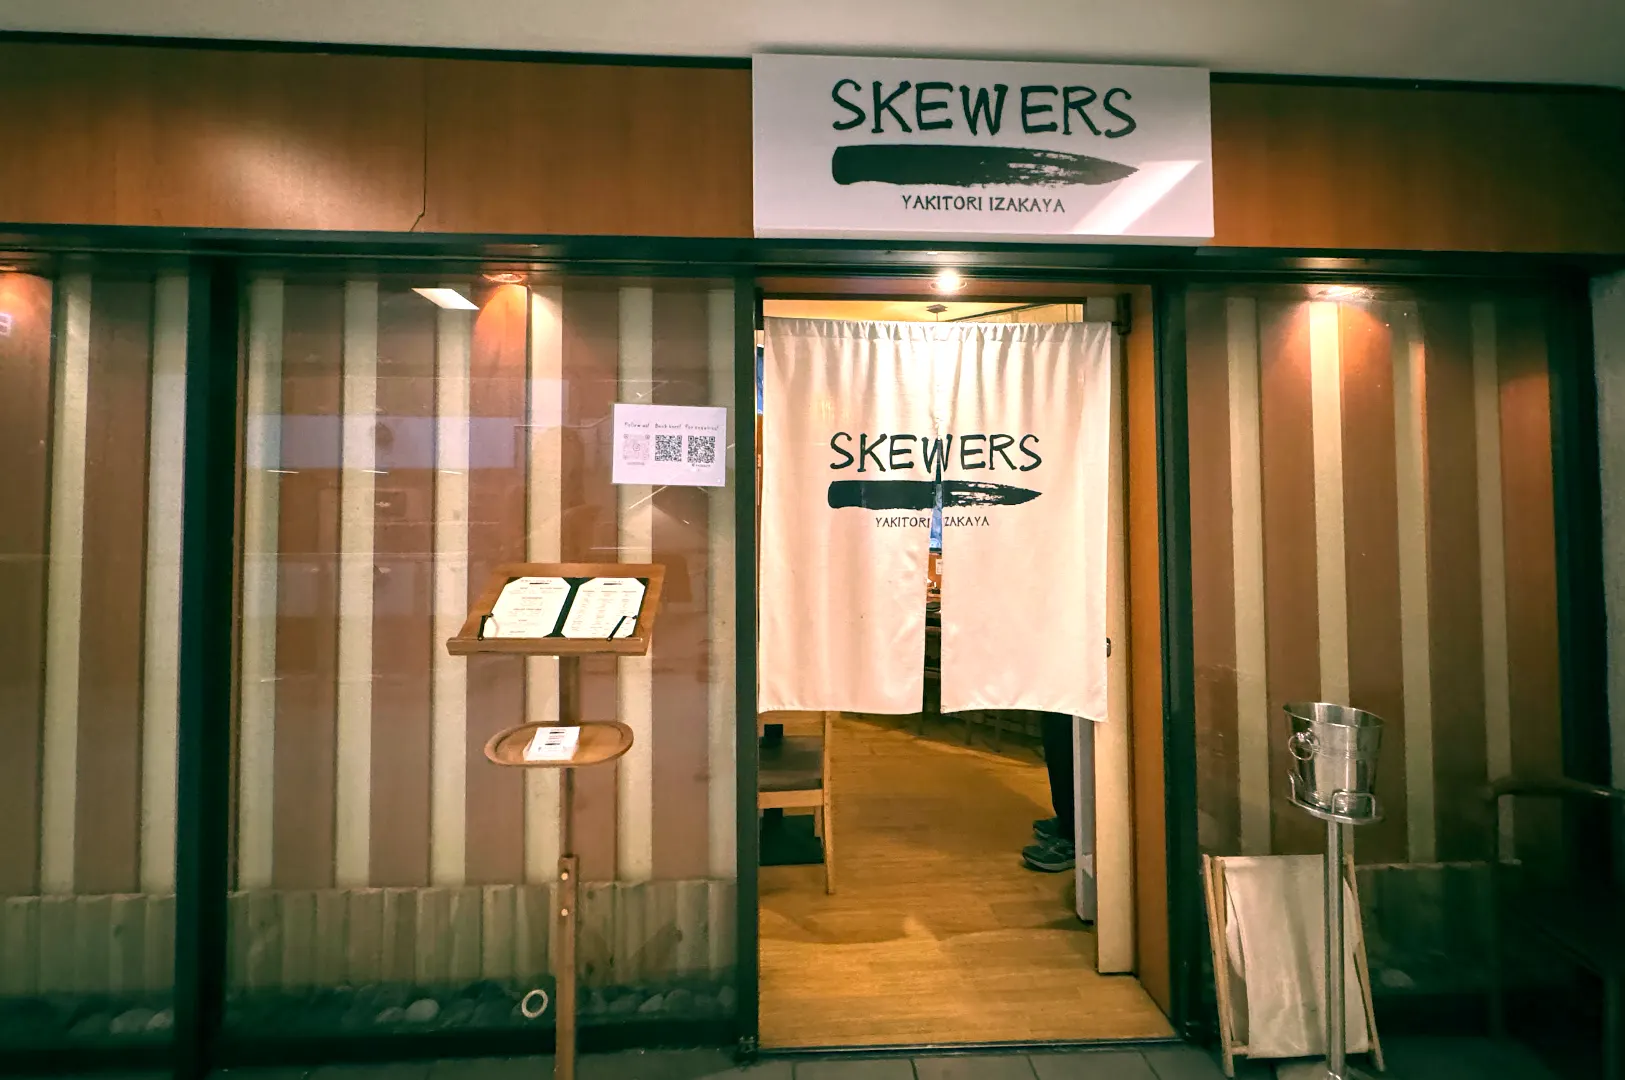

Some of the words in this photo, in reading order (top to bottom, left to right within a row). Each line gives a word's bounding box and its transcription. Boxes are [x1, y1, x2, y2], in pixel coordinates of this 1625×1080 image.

[831, 78, 1137, 139] SKEWERS
[901, 194, 983, 212] YAKITORI
[989, 196, 1066, 213] IZAKAYA
[830, 431, 1043, 473] SKEWERS
[875, 516, 930, 529] YAKITORI
[944, 515, 990, 527] ZAKAYA
